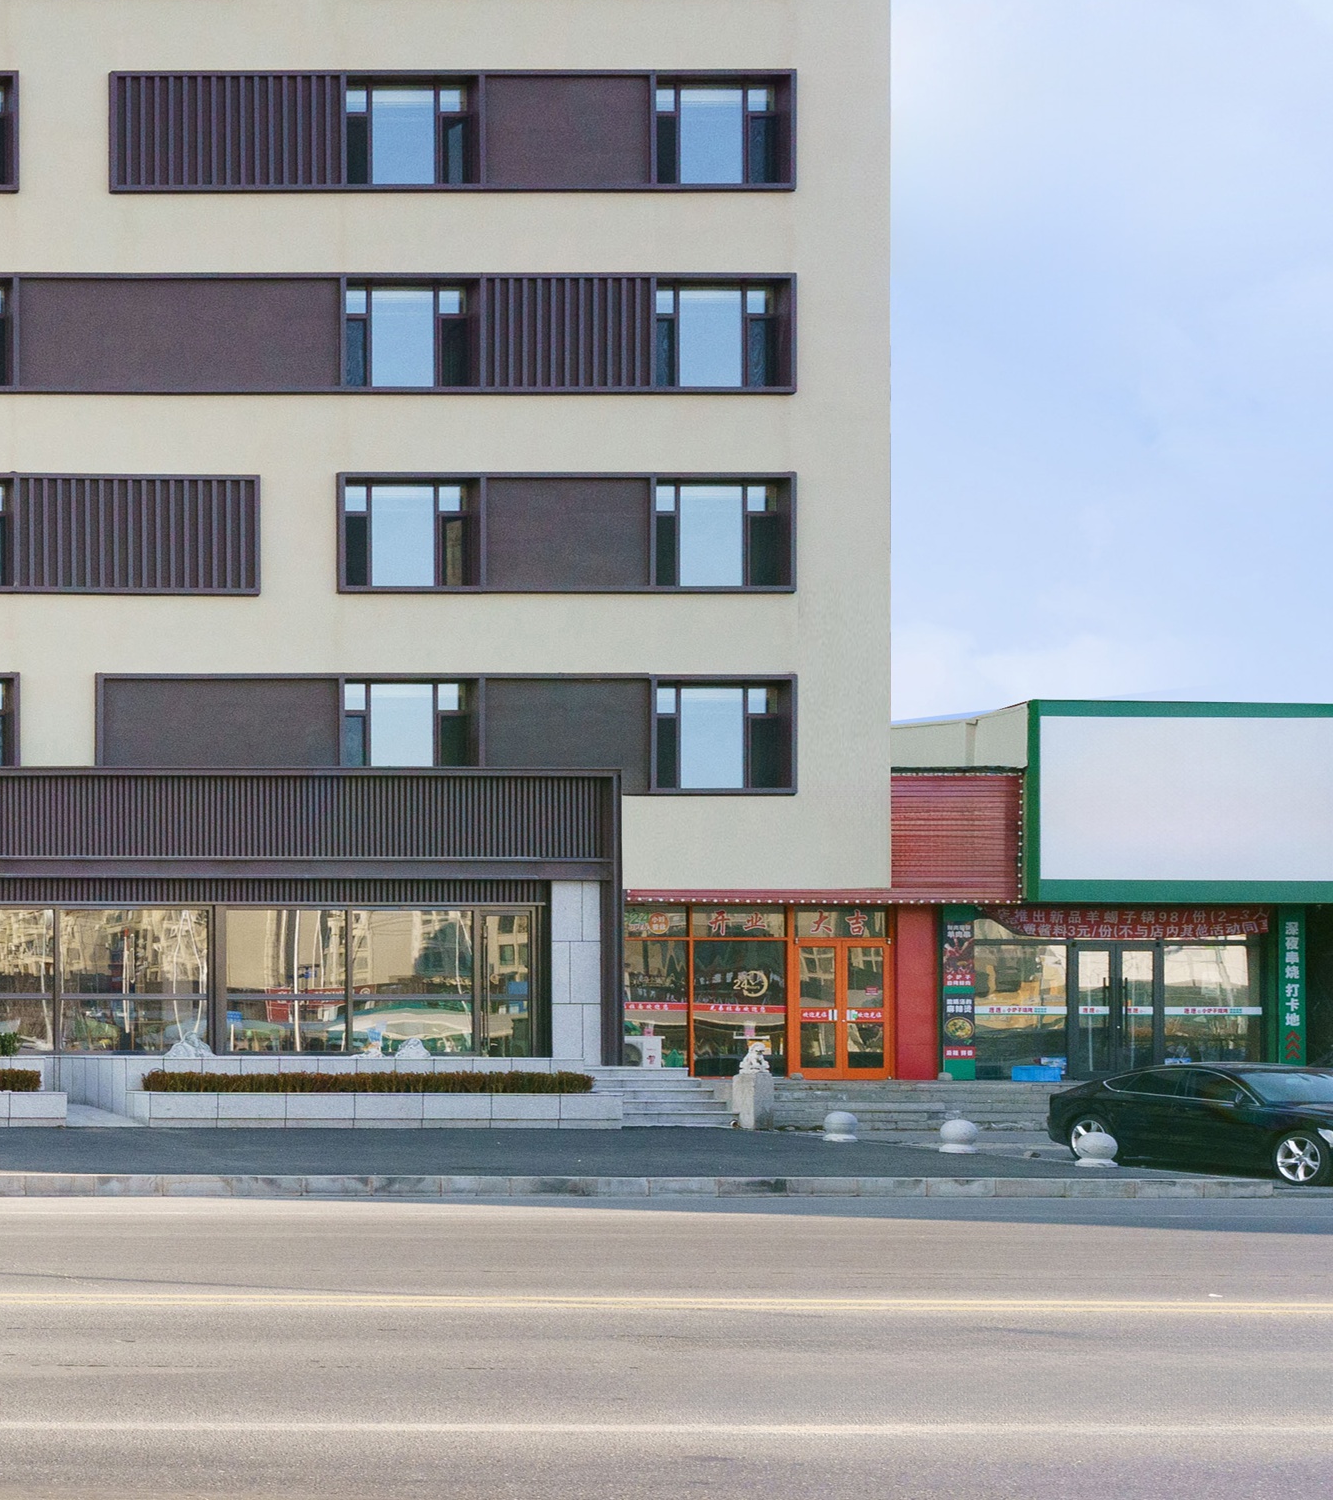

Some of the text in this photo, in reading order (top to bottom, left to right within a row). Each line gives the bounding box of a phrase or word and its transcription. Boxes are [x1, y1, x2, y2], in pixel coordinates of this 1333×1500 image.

[733, 979, 748, 990] 24
[1285, 983, 1300, 1027] 打卡地
